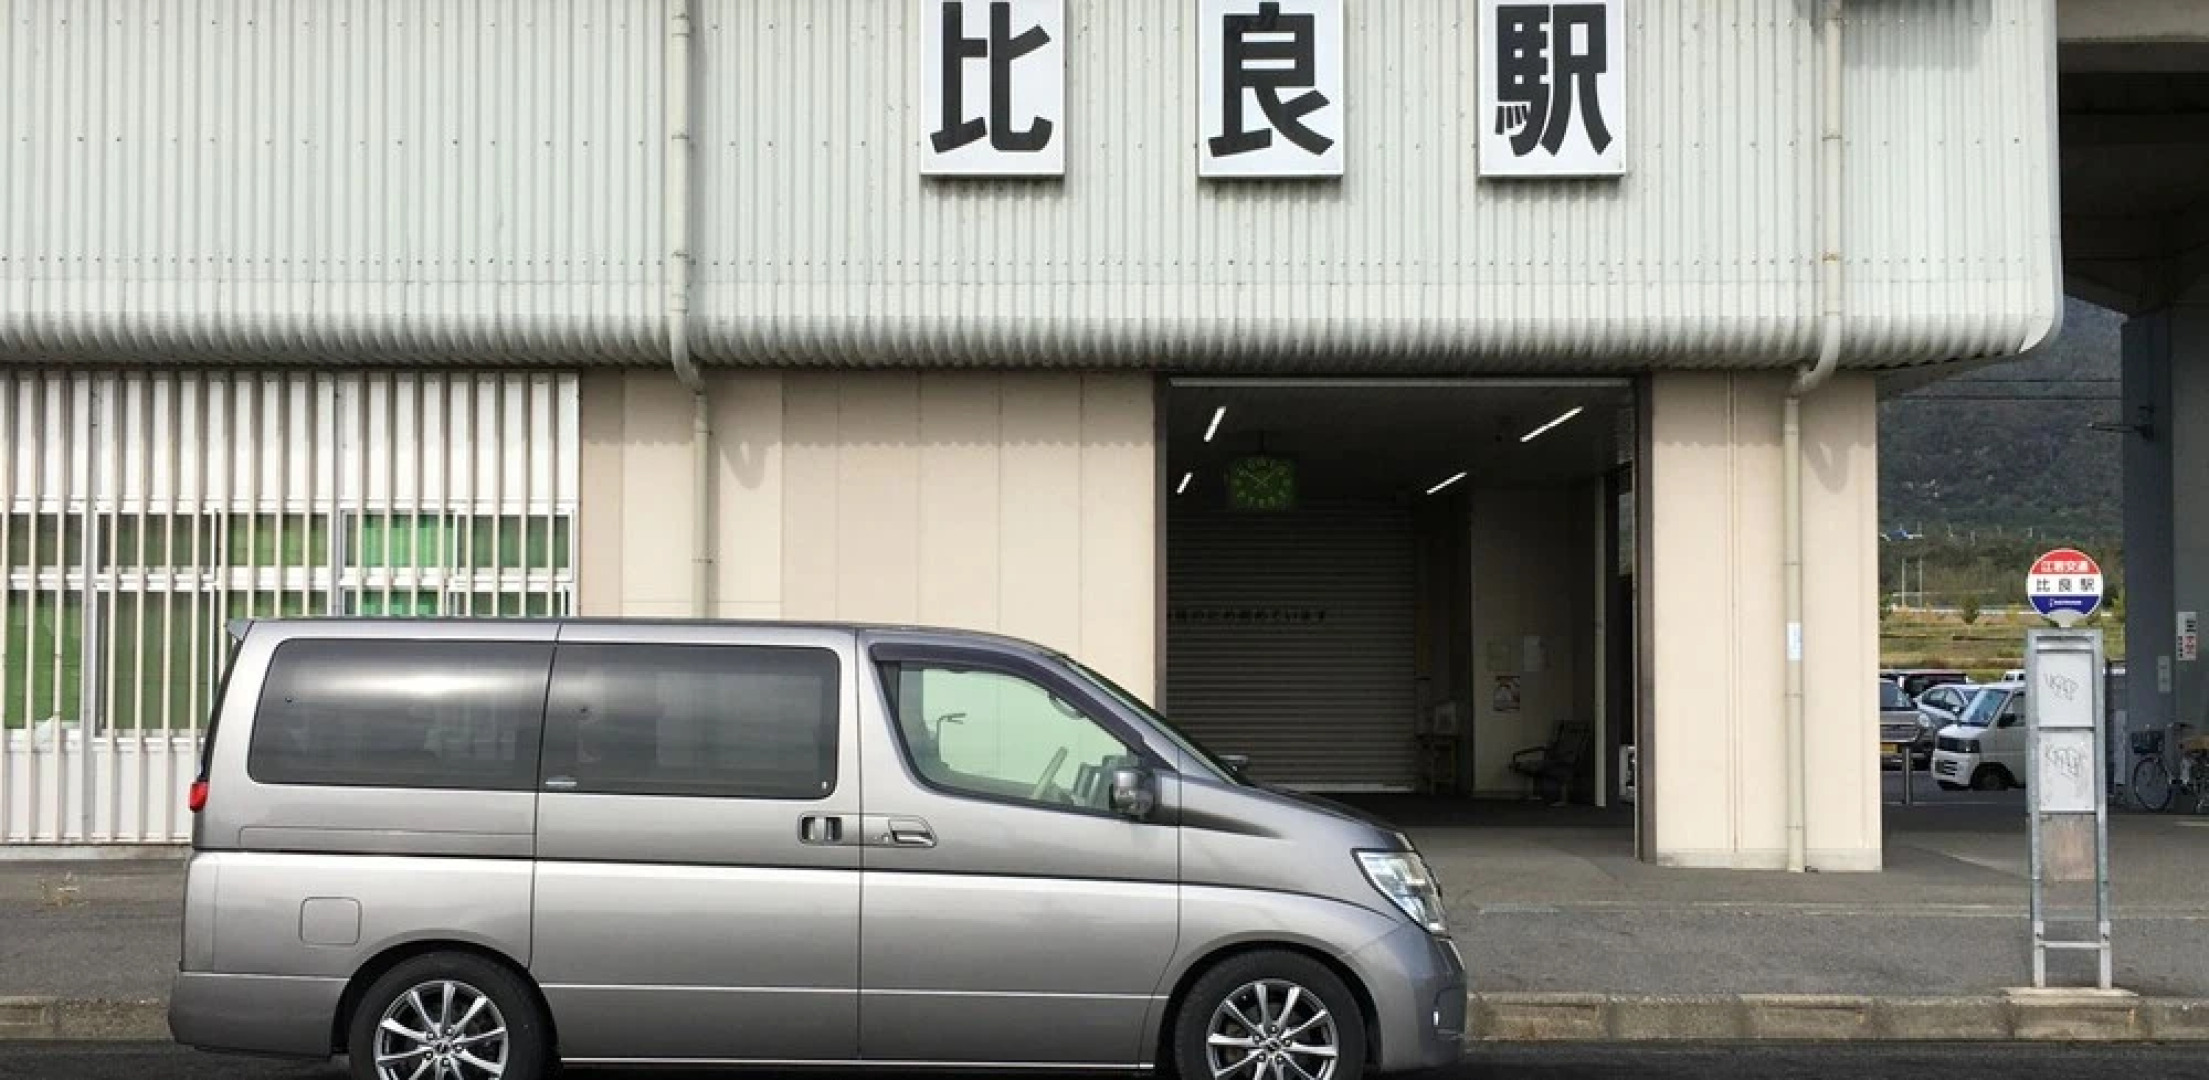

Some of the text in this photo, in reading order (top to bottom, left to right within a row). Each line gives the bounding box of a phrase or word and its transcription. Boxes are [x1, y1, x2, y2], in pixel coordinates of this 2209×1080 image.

[930, 1, 1612, 157] 比 良 駅
